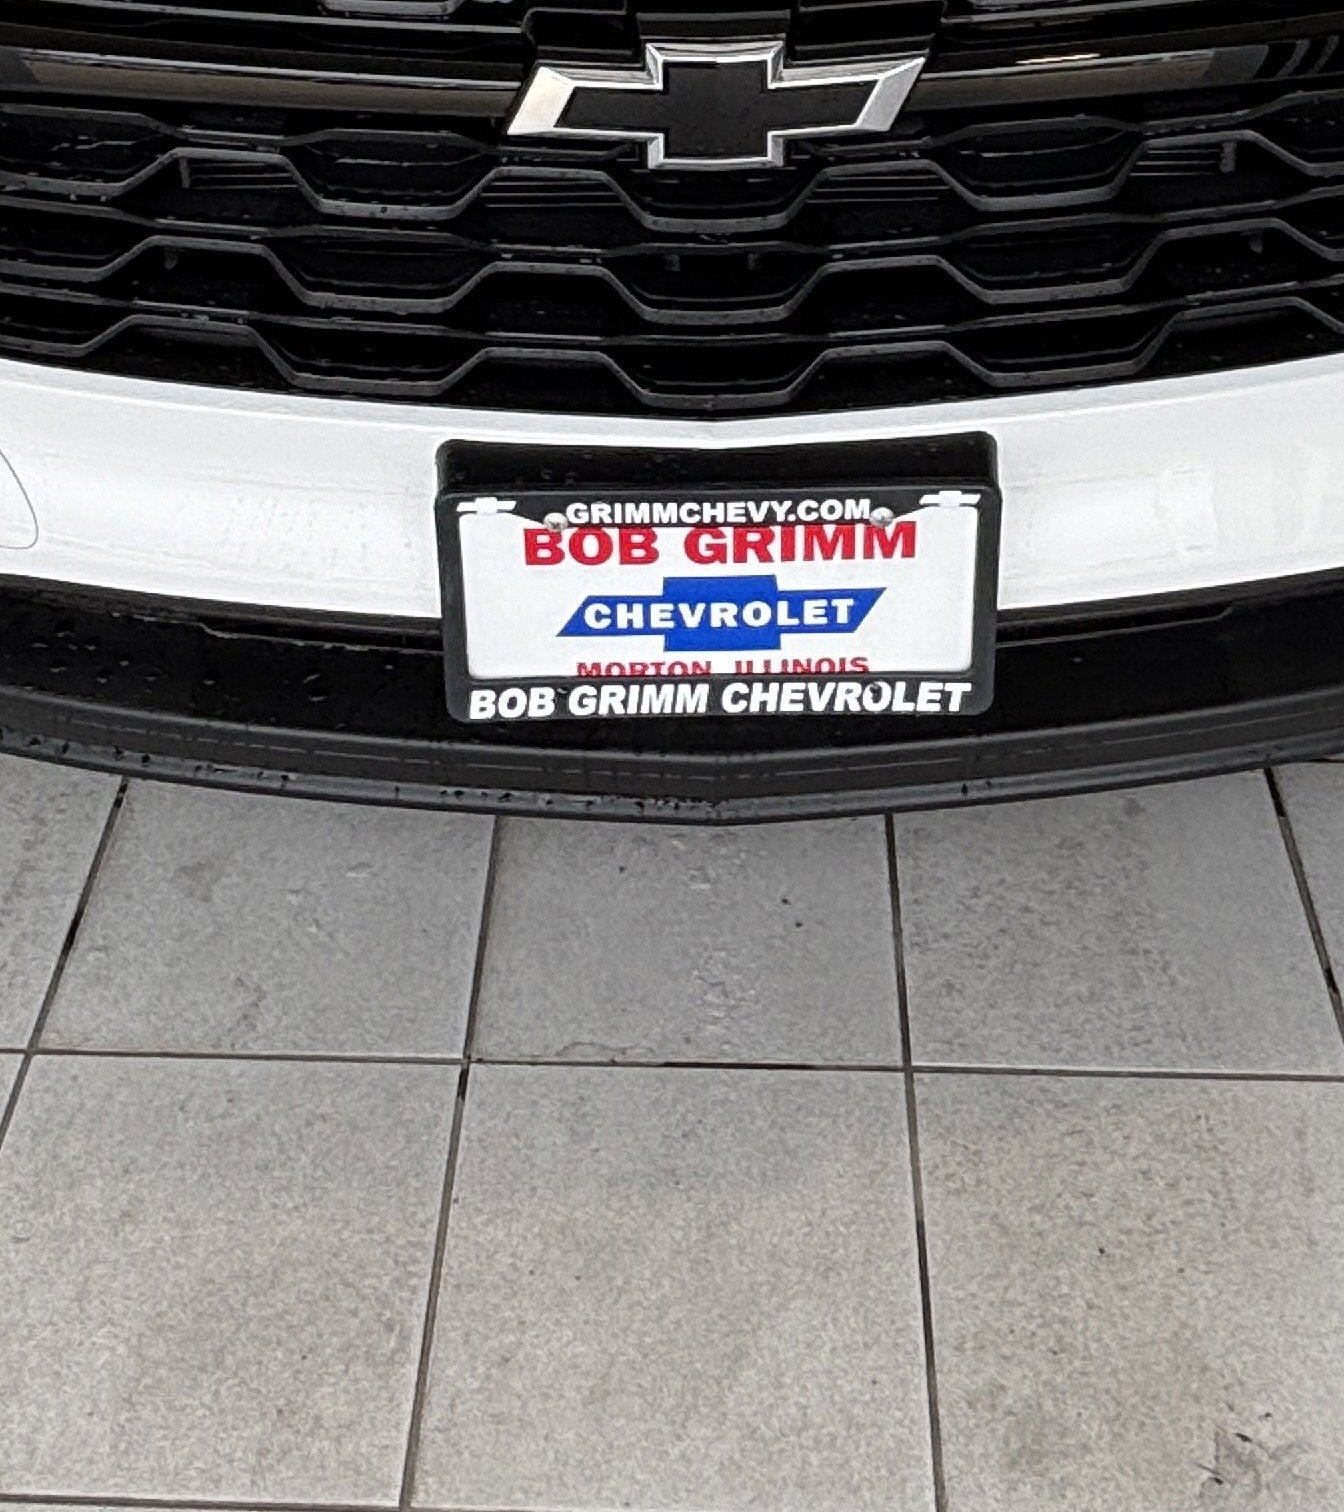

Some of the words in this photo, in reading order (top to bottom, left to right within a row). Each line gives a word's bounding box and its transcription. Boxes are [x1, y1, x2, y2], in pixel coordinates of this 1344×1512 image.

[565, 498, 871, 524] GRIMMCHEVY.COM
[523, 526, 660, 566] BOB
[683, 520, 917, 566] GRIMM
[584, 598, 855, 630] CHEVROLET
[468, 687, 557, 720] BOB
[567, 683, 710, 717] GRIMM
[721, 680, 972, 715] CHEVROLET
